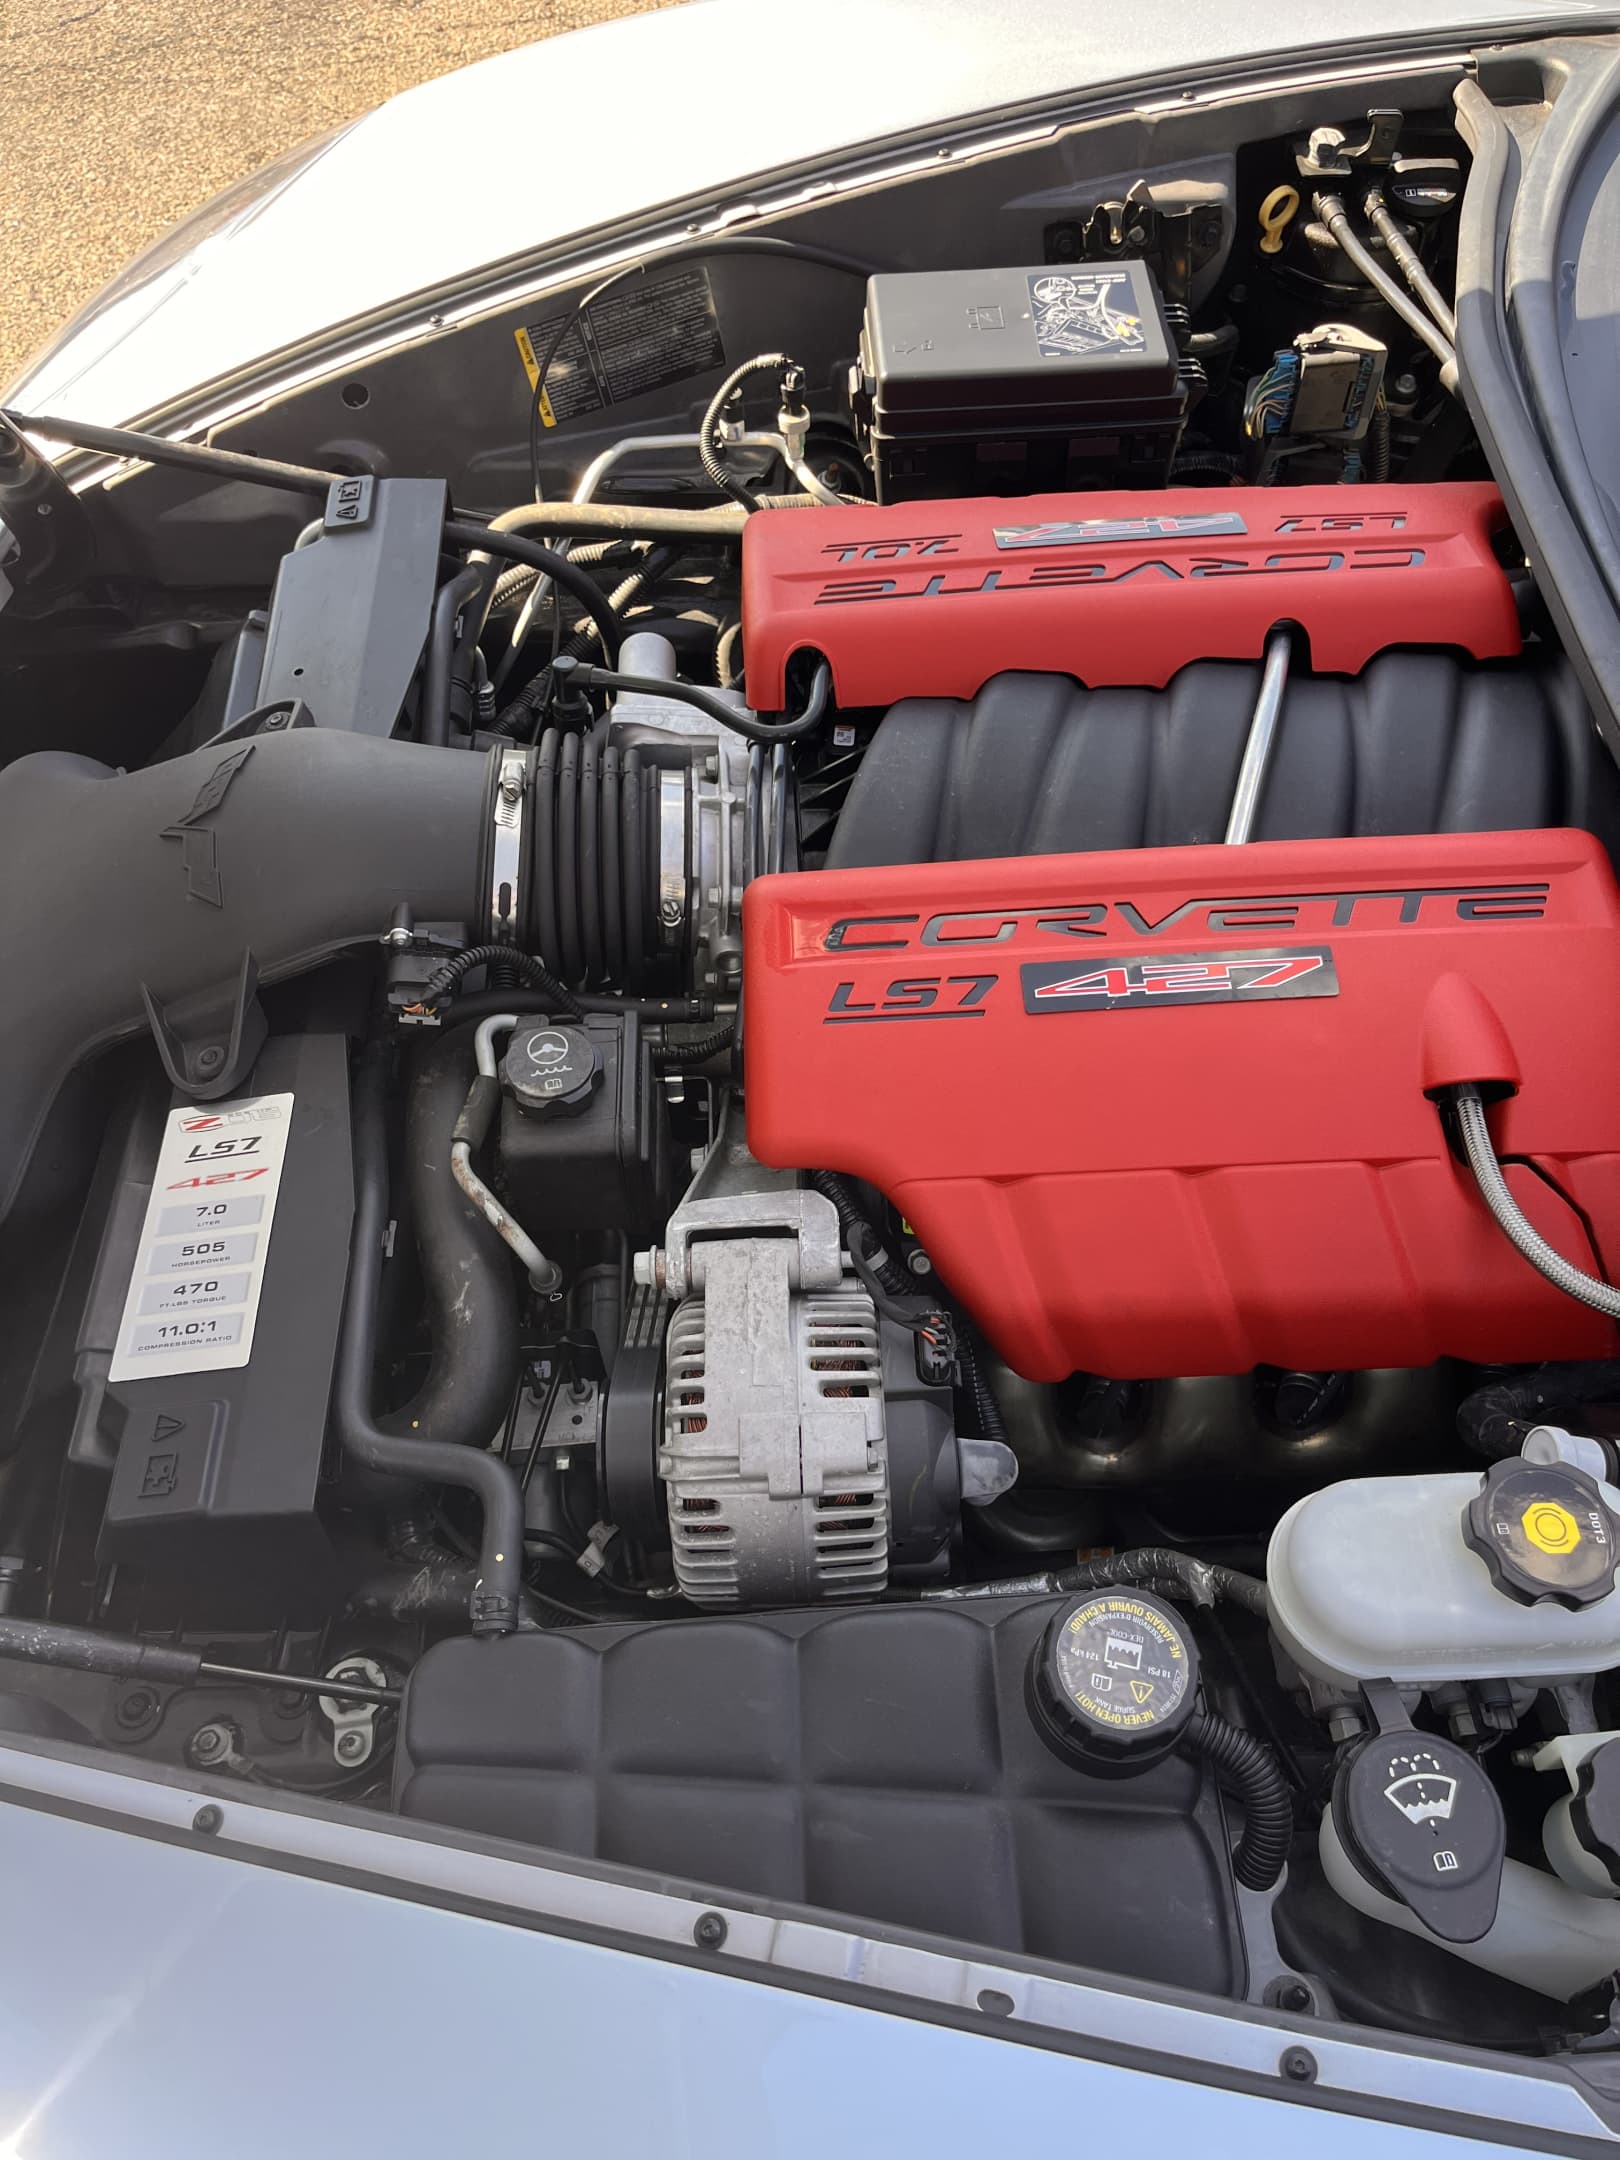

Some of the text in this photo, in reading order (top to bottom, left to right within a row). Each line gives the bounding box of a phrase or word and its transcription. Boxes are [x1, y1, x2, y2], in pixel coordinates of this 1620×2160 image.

[1005, 516, 1234, 543] 427
[1275, 514, 1407, 533] LS7
[821, 537, 960, 562] 7.0L
[814, 548, 1426, 605] CORVETTE
[823, 883, 1550, 952] CORVETTE
[1034, 955, 1323, 998] 427
[827, 974, 999, 1014] LS7
[186, 1136, 262, 1160] LS7
[166, 1168, 269, 1190] 427
[196, 1204, 227, 1217] 7.0
[197, 1220, 220, 1228] LITER
[181, 1241, 226, 1257] 505
[171, 1256, 231, 1268] HORSEPOWER
[173, 1281, 219, 1296] 470
[192, 1296, 227, 1305] TORQUE
[158, 1321, 217, 1338] 11.0:1
[137, 1335, 232, 1351] COMPRESSION RATIO
[1108, 1601, 1144, 1615] OUVRIR
[1069, 1605, 1099, 1634] CHAUD!
[1145, 1611, 1176, 1643] JAMAIS
[1169, 1643, 1182, 1659] NE
[1147, 1666, 1161, 1678] PSI
[1075, 1690, 1155, 1725] NEVER OPEN HOT!
[1094, 1696, 1136, 1714] SURGE TANK
